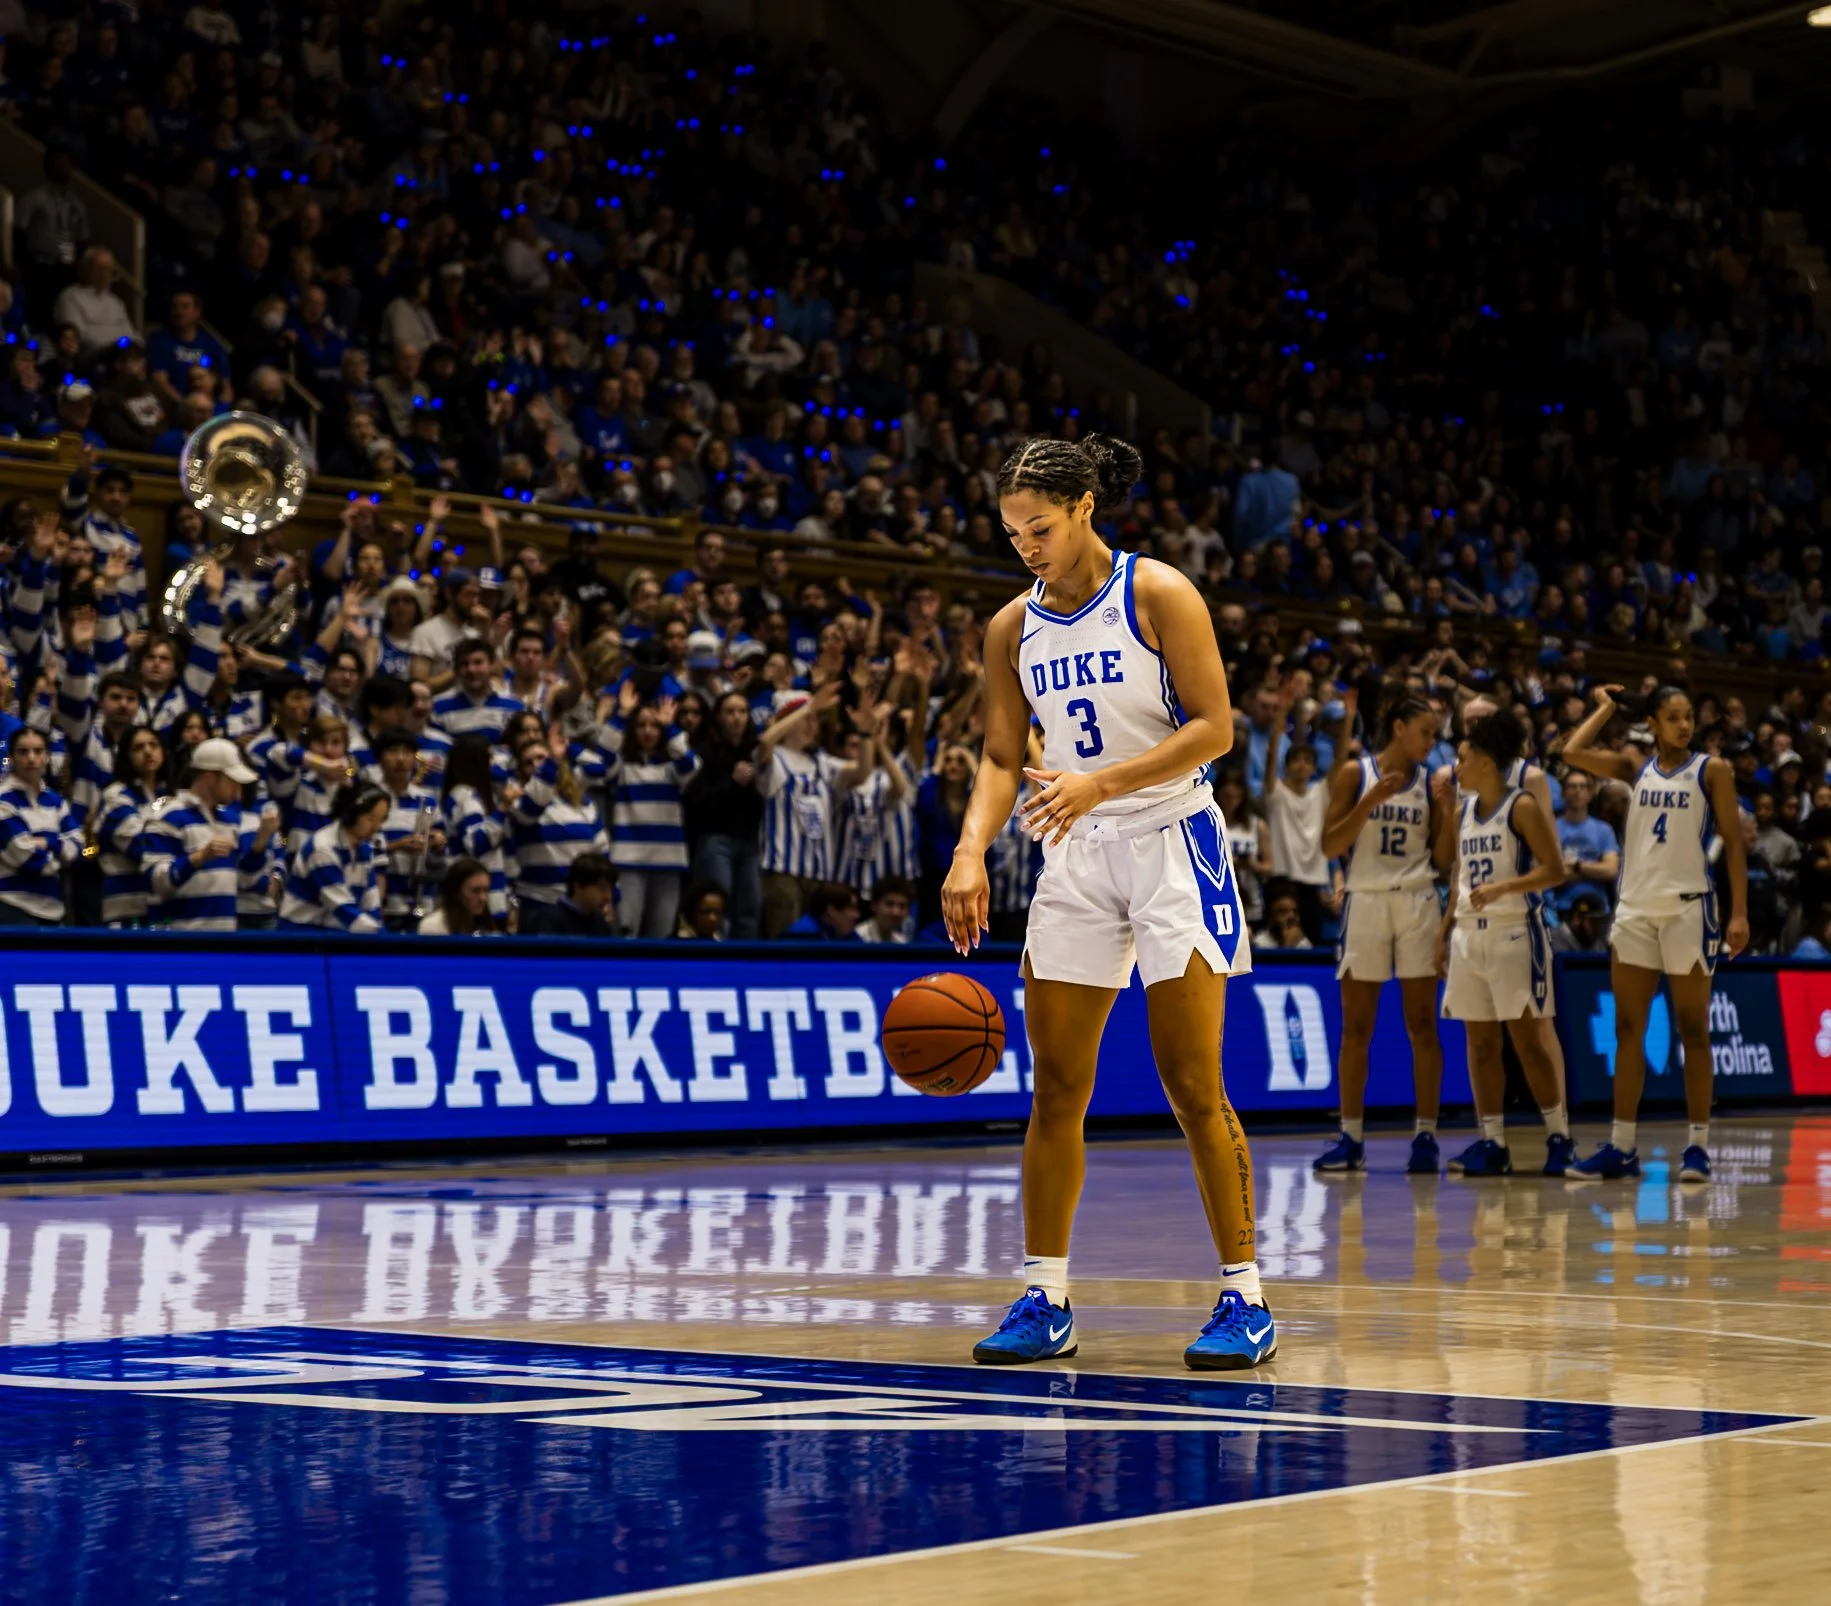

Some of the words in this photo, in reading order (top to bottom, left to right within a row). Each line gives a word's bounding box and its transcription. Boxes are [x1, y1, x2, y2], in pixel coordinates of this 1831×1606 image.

[1030, 650, 1124, 697] DUKE
[1066, 698, 1104, 758] 3
[1640, 789, 1690, 809] DUKE
[1380, 826, 1407, 857] 12
[1653, 812, 1668, 843] 4
[1462, 835, 1502, 856] DUKE
[1468, 858, 1494, 889] 22
[1708, 990, 1740, 1033] rth
[0, 983, 321, 1119] UKE
